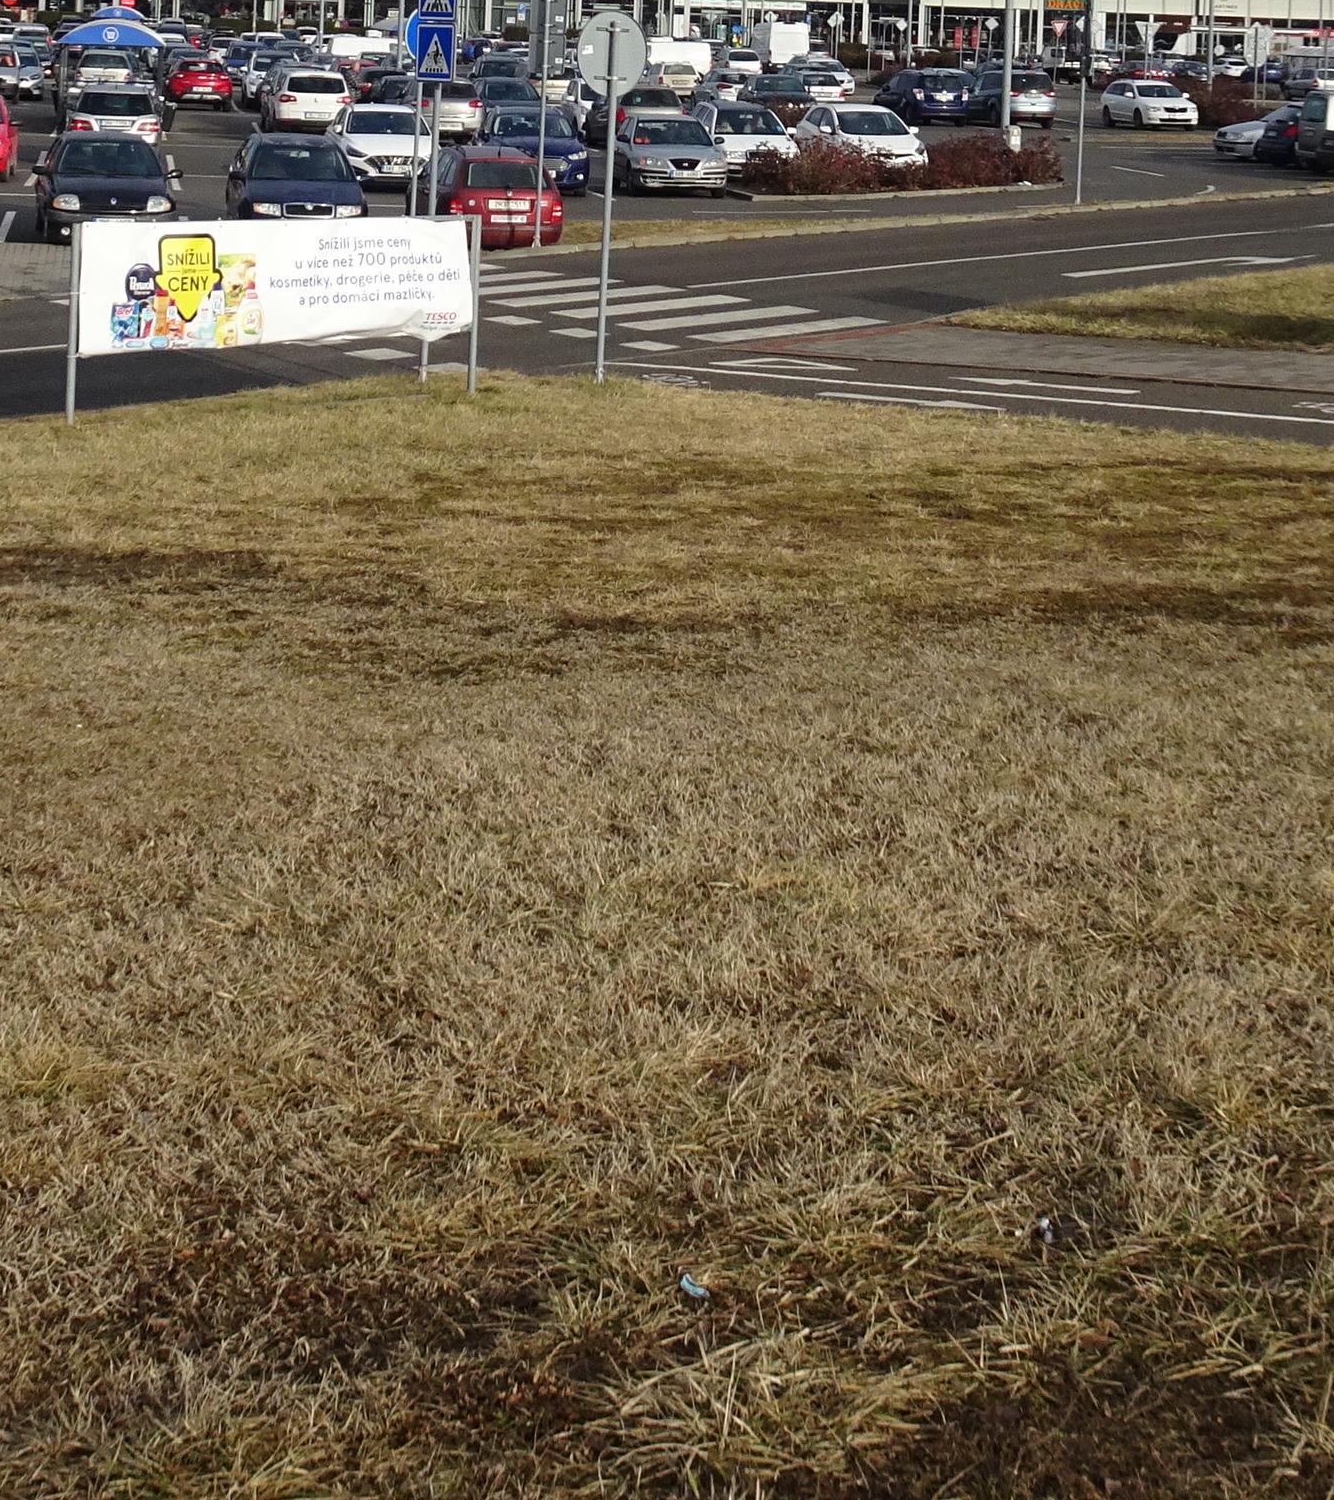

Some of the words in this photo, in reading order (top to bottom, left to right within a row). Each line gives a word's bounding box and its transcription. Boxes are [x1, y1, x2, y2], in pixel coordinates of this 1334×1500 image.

[318, 237, 350, 250] Snížili
[353, 238, 384, 251] jsme
[387, 238, 412, 251] ceny
[167, 248, 210, 266] SNÍŽILI
[295, 261, 303, 269] u
[307, 256, 328, 269] více
[333, 255, 354, 268] než
[358, 252, 386, 266] 700
[390, 251, 442, 267] produktů
[168, 276, 209, 292] CENY
[269, 276, 333, 290] kosmetiky,
[336, 271, 395, 288] drogerie,
[398, 271, 424, 284] péče
[426, 274, 435, 282] o
[438, 268, 461, 281] děti
[299, 297, 305, 305] a
[309, 295, 329, 308] pro
[332, 291, 380, 304] domácí
[426, 312, 457, 321] TESCO
